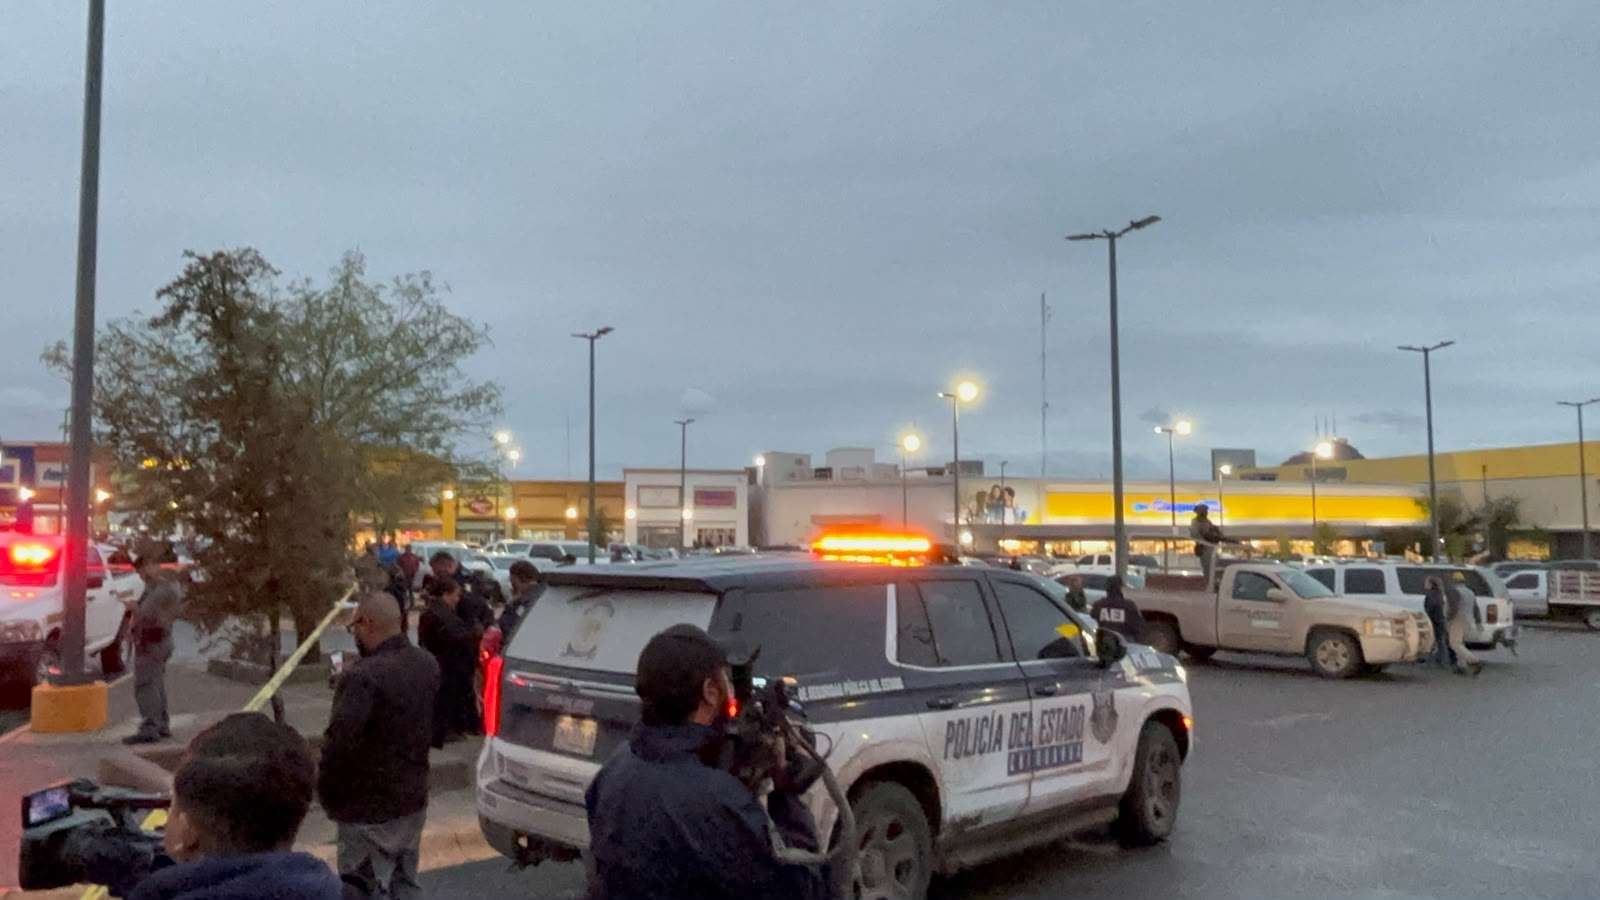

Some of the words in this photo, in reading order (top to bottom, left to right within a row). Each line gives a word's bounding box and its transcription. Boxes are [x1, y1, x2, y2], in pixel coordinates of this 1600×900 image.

[944, 709, 1004, 760] POLICÍA
[1007, 711, 1033, 750] DEL
[1039, 705, 1085, 746] ESTADO
